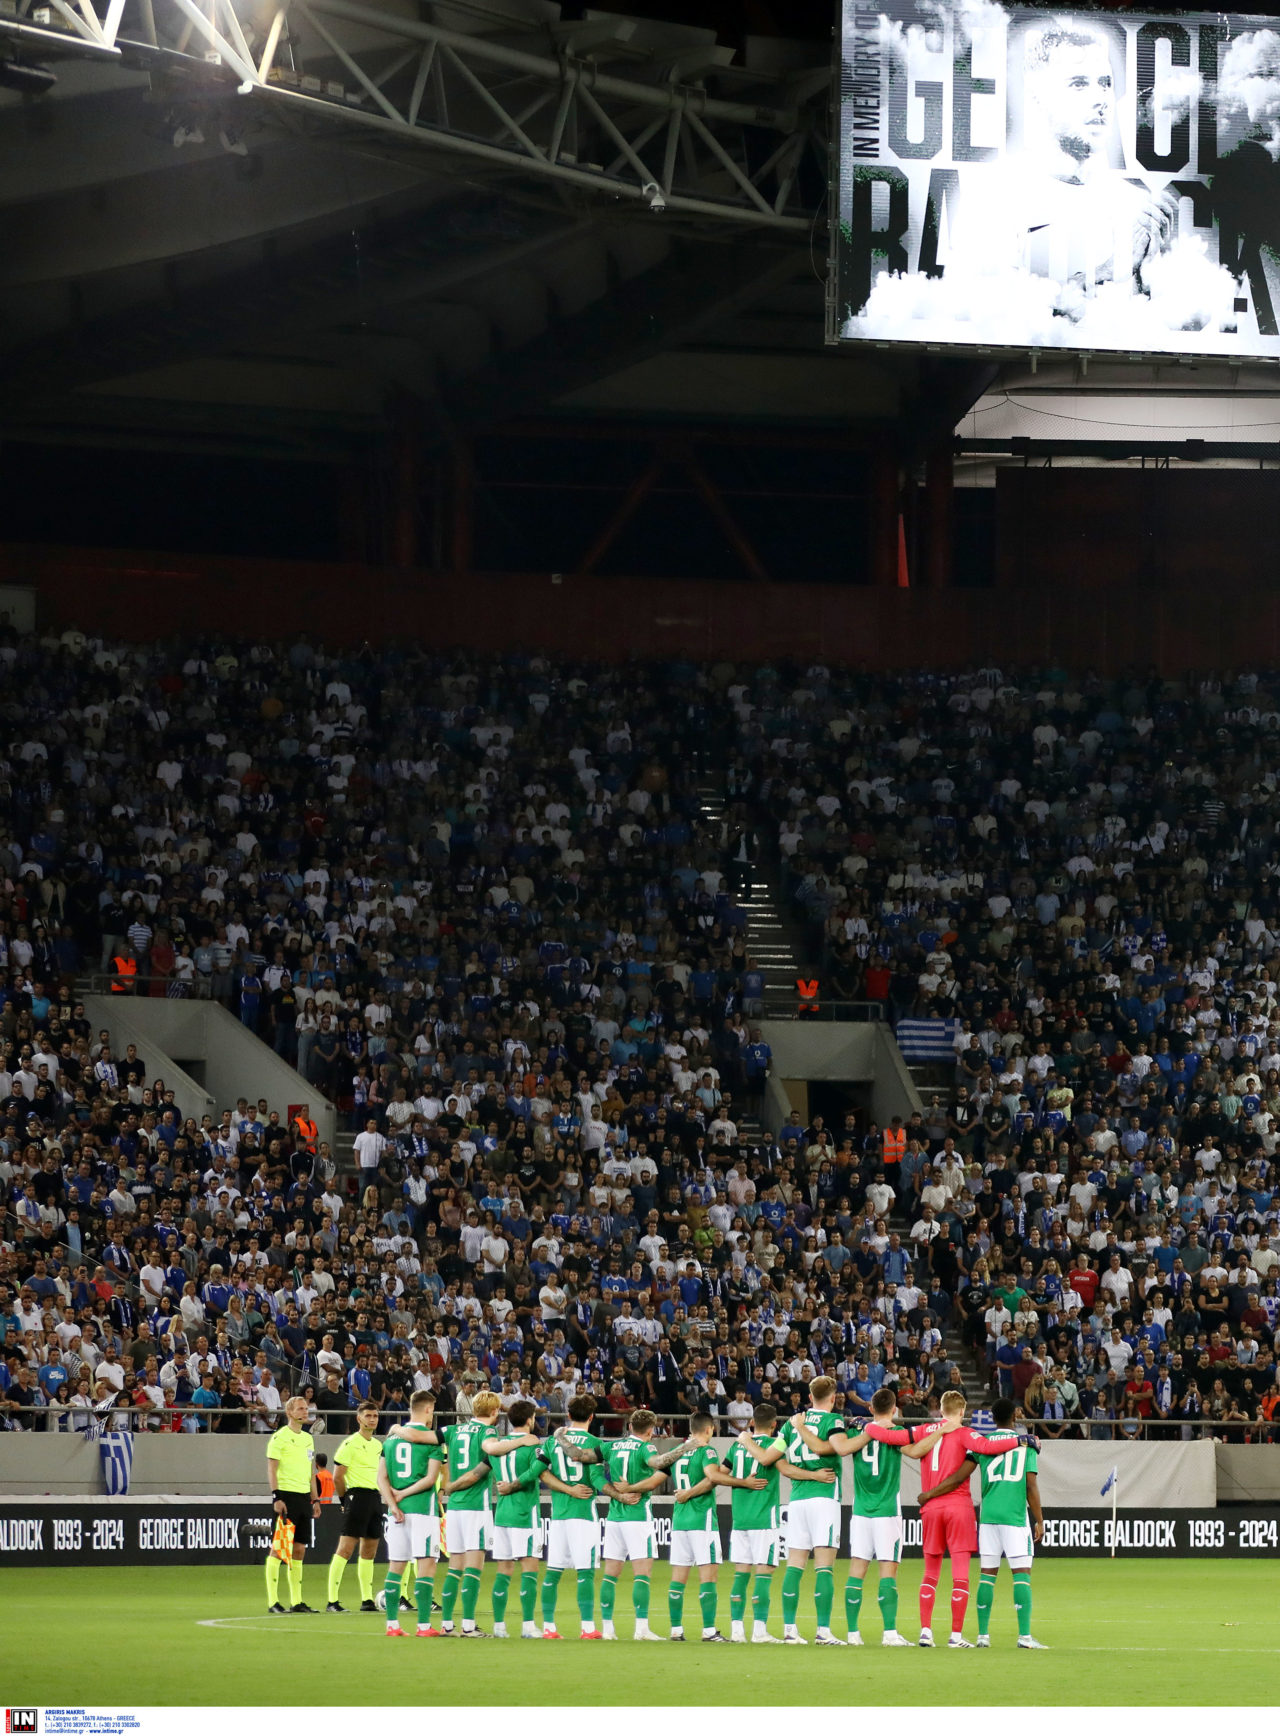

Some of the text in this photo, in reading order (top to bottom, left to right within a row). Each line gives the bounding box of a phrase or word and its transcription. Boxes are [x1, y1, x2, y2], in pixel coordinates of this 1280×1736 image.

[852, 36, 880, 131] MEMORY
[852, 135, 880, 158] IN
[396, 1443, 412, 1478] 9
[457, 1434, 471, 1469] 3
[789, 1425, 820, 1463] 22
[862, 1440, 880, 1476] 4
[931, 1434, 944, 1471] 1
[500, 1449, 518, 1483] 11
[554, 1446, 583, 1481] 15
[617, 1451, 631, 1480] 7
[675, 1459, 692, 1490] 6
[735, 1449, 760, 1480] 17
[987, 1446, 1028, 1482] 20
[53, 1520, 81, 1550] 1993
[93, 1520, 124, 1549] 2024
[140, 1519, 184, 1549] GEORGE
[187, 1519, 239, 1549] BALDOCK
[1042, 1519, 1099, 1547] GEORGE
[1104, 1519, 1176, 1548] BALDOCK
[1188, 1520, 1224, 1547] 1993
[1240, 1520, 1278, 1547] 2024
